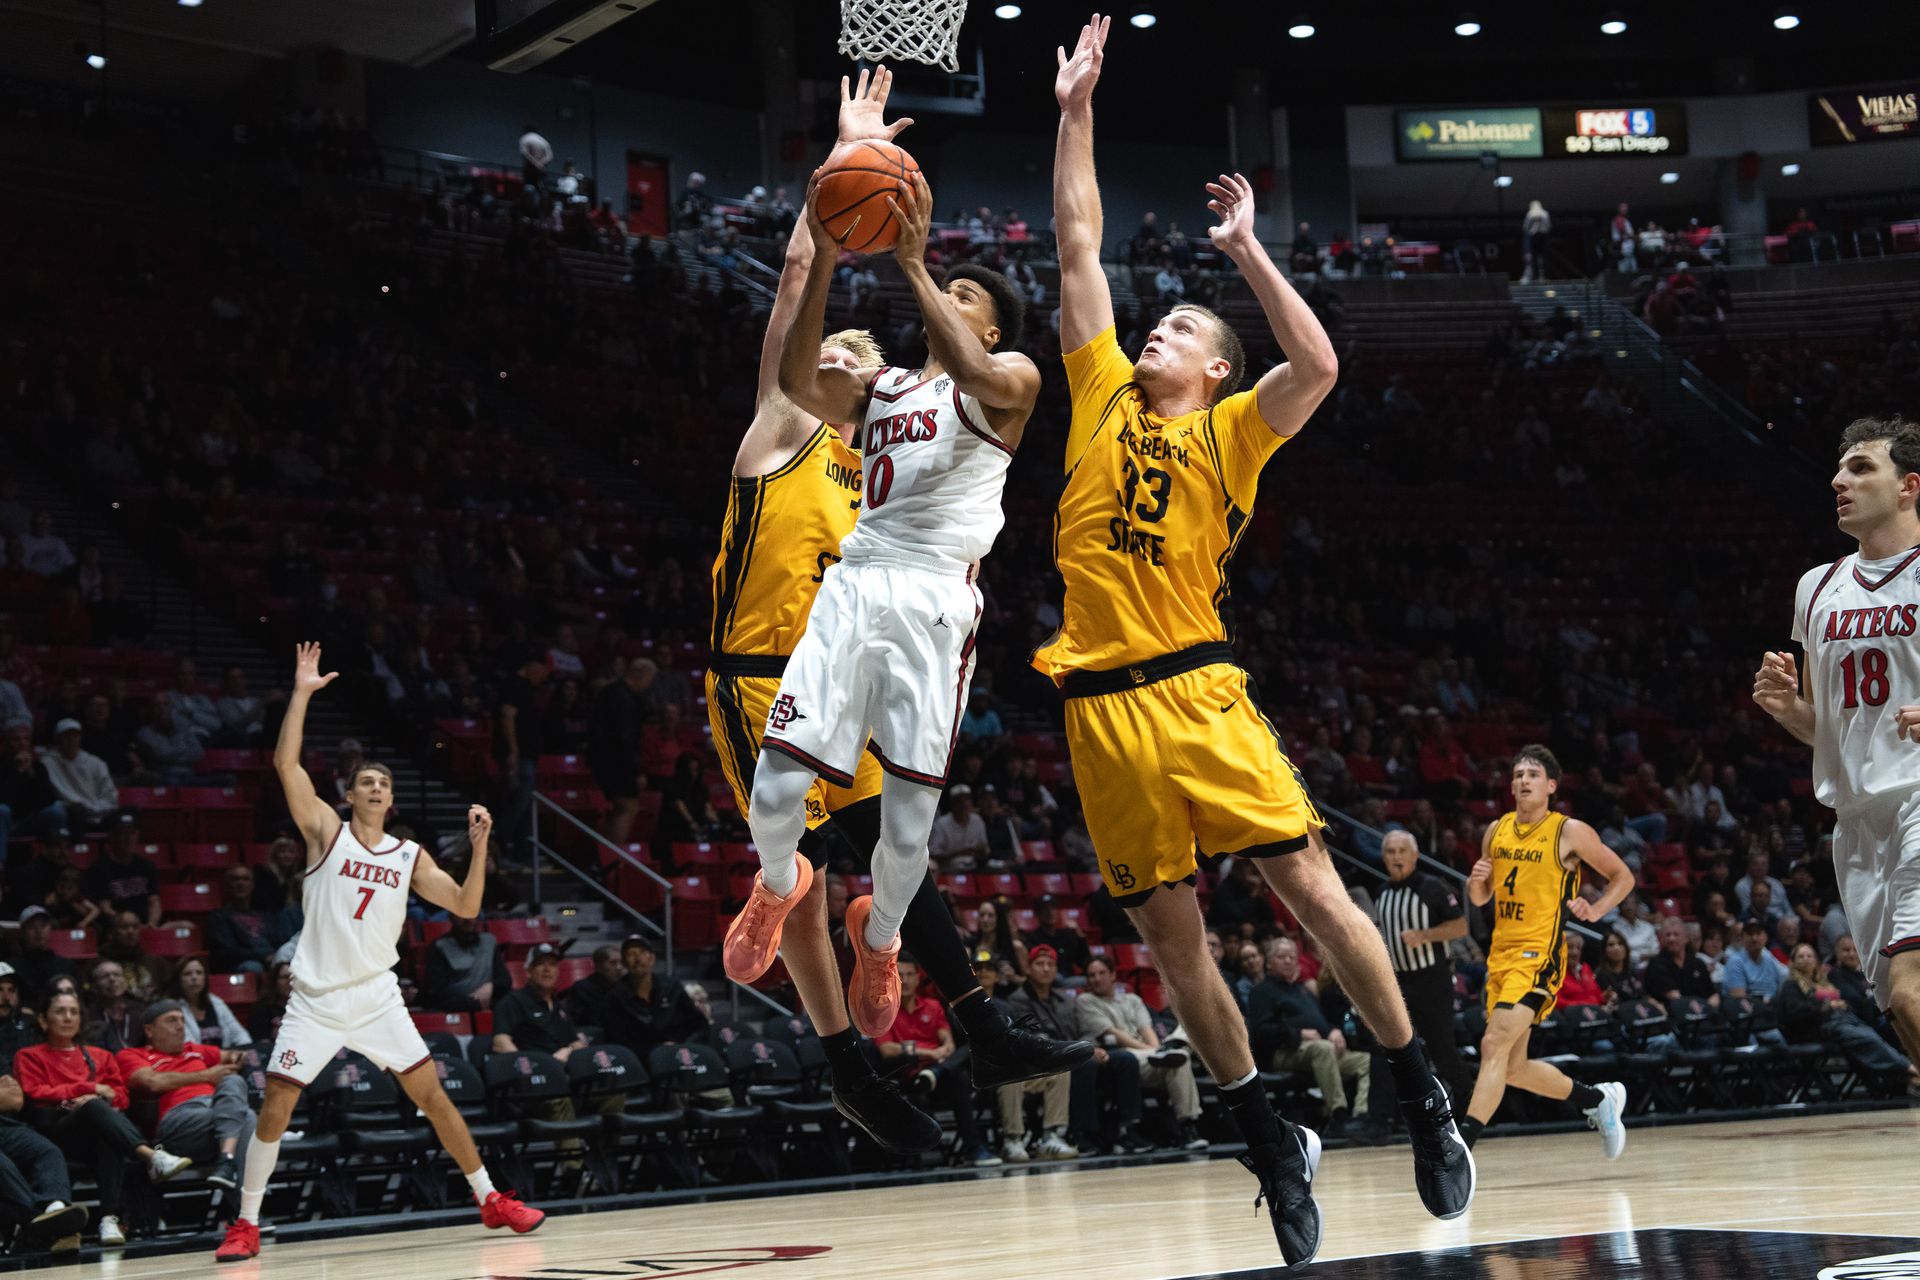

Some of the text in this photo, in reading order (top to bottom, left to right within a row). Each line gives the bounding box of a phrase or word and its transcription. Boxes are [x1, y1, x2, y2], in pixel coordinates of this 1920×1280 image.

[1438, 120, 1535, 143] Palomar
[1580, 111, 1650, 135] FOX 5
[1592, 136, 1622, 152] San
[1622, 135, 1669, 153] Diego
[825, 457, 863, 492] LONG
[867, 454, 894, 510] 0
[1822, 603, 1919, 643] AZTECS
[1840, 648, 1890, 709] 18
[1494, 846, 1543, 863] LONG BEACH
[338, 858, 401, 889] AZTECS
[1503, 866, 1519, 896] 4
[353, 886, 376, 920] 7
[1498, 900, 1525, 921] TATE
